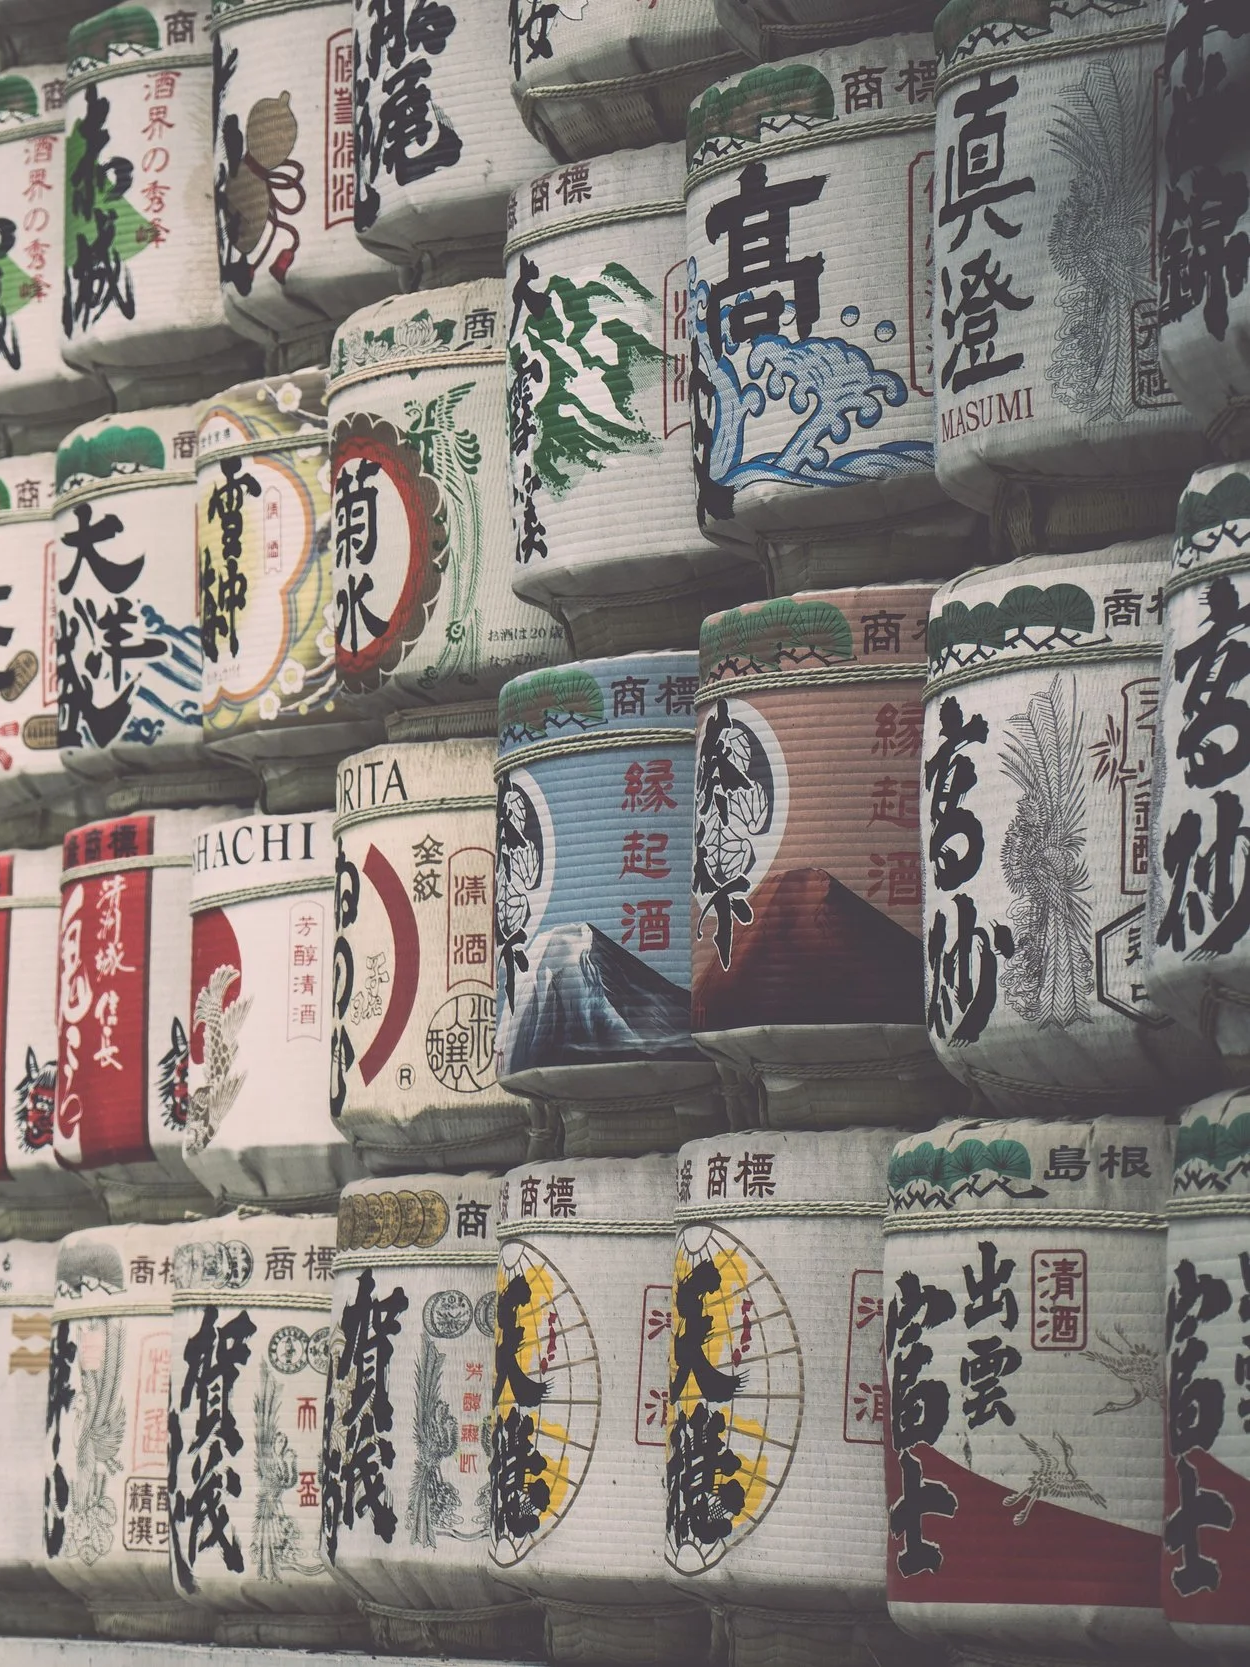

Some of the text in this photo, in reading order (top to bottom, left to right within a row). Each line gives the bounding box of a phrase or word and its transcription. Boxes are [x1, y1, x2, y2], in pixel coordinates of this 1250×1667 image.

[941, 387, 1035, 444] MASUMI
[334, 458, 390, 657] 菊水
[193, 821, 317, 871] HACHI
[618, 758, 679, 953] 縁起酒
[1044, 1145, 1152, 1182] 島根
[1036, 1257, 1085, 1347] 清酒
